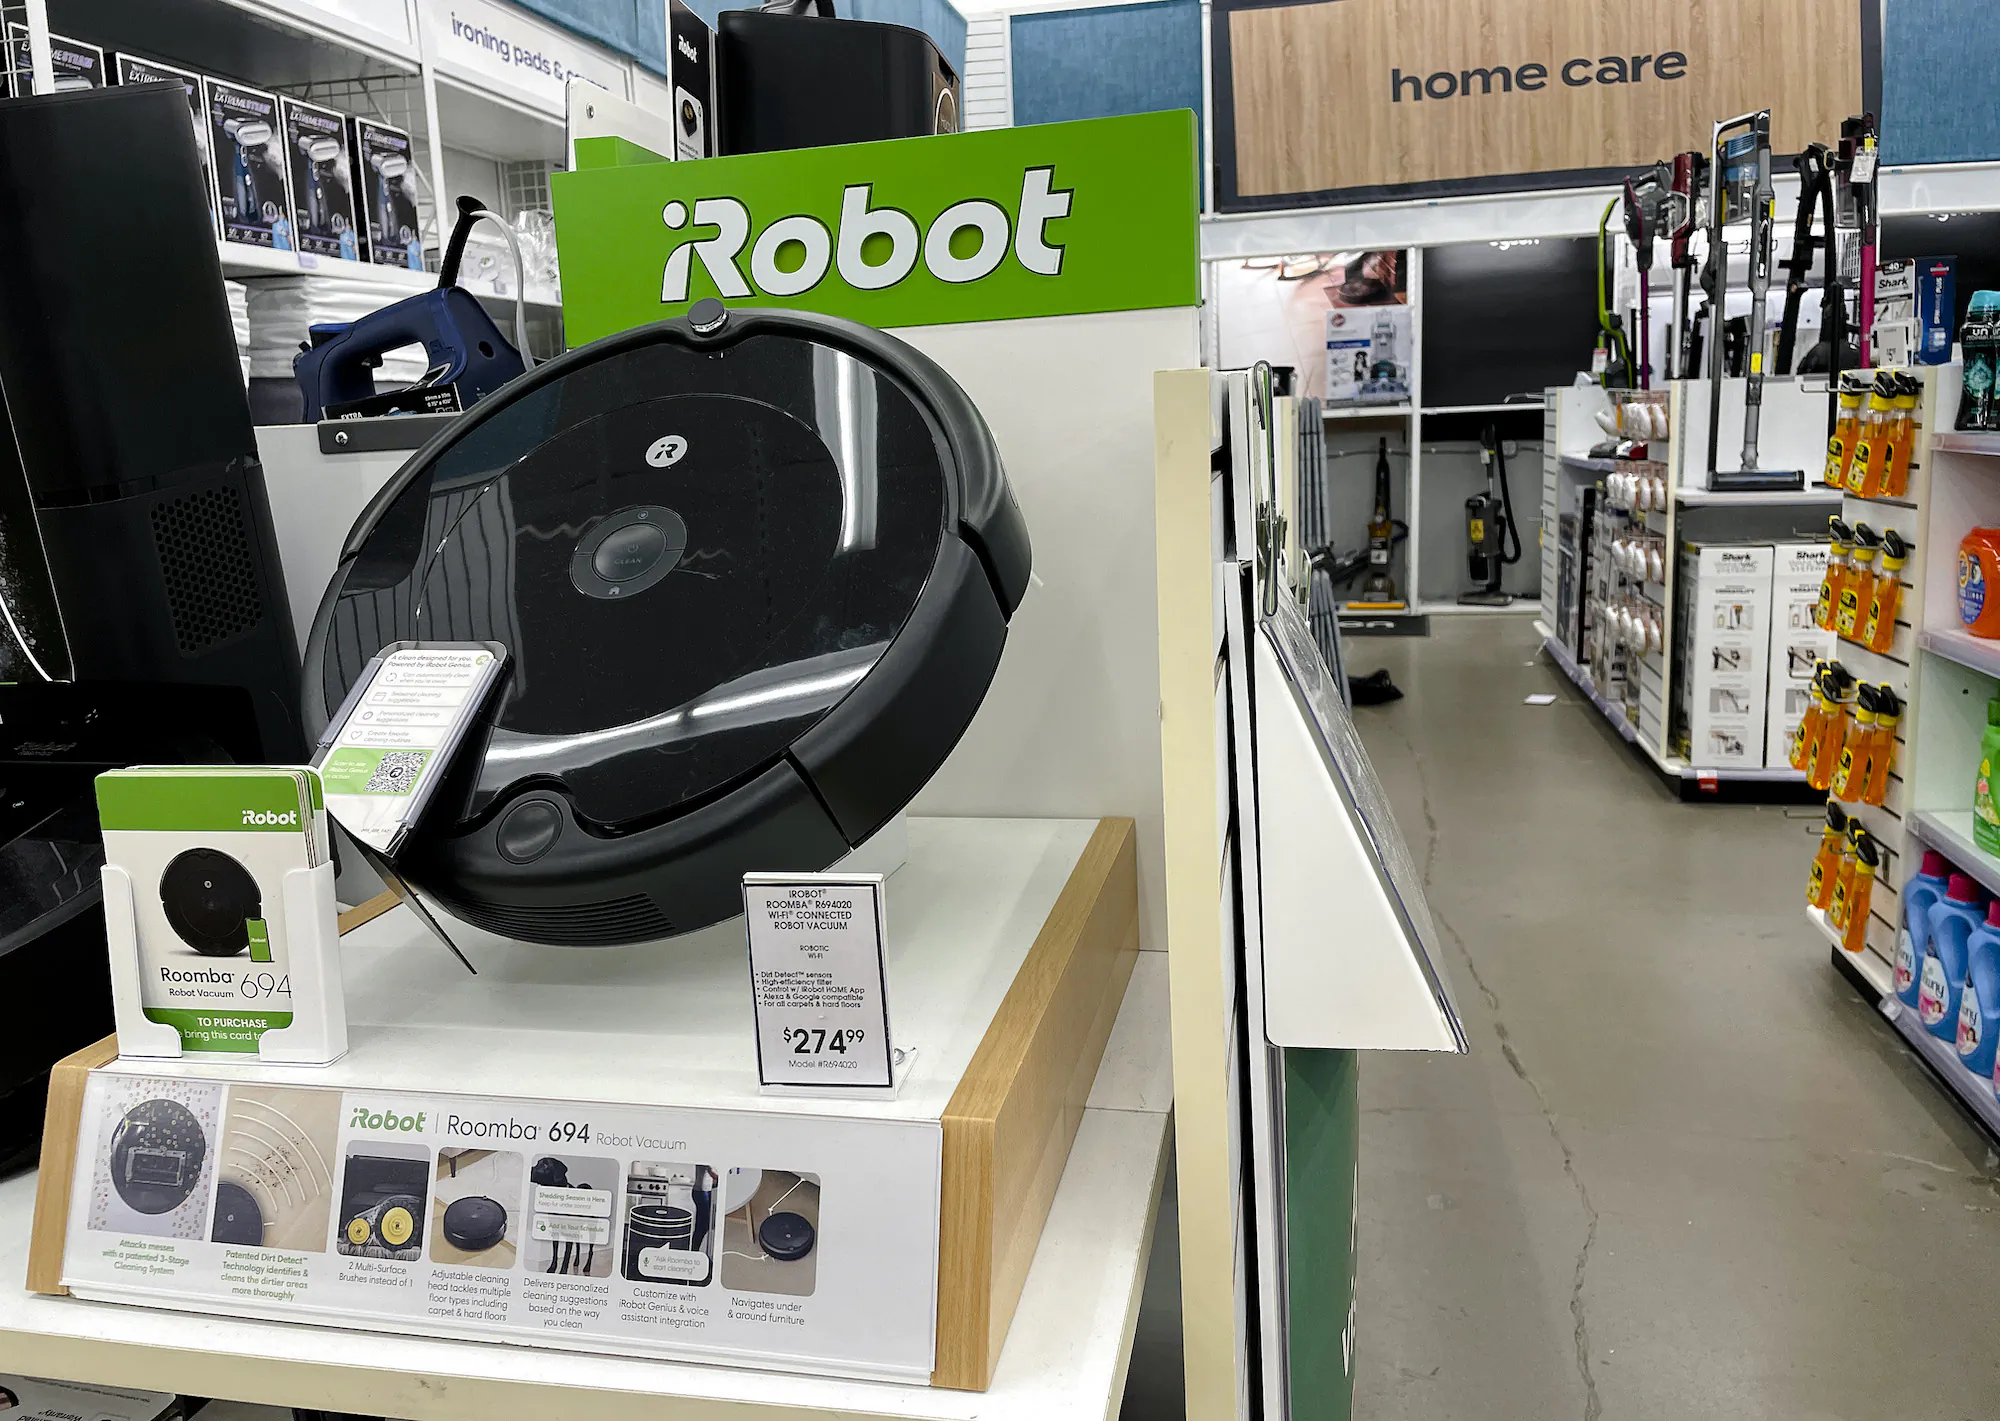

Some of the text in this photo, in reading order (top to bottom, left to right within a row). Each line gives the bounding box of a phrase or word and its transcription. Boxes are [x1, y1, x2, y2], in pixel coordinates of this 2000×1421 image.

[452, 13, 510, 62] ironing
[514, 46, 550, 75] pads
[554, 61, 563, 80] &
[1392, 51, 1687, 102] home care
[661, 164, 1074, 303] iRobot
[1879, 276, 1908, 289] Shark
[341, 412, 363, 420] EXTRA
[1722, 553, 1752, 561] Shark
[1797, 552, 1825, 560] Shark
[242, 810, 296, 825] iRobot
[815, 901, 852, 909] R694020
[169, 988, 234, 998] Robot Vacuum
[240, 973, 292, 999] 694
[197, 1017, 267, 1028] TO PURCHASE
[185, 1029, 209, 1041] bring
[211, 1030, 227, 1040] this
[229, 1030, 253, 1040] card
[789, 1060, 815, 1068] Model
[350, 1107, 426, 1133] iRobot
[549, 1121, 590, 1143] 694
[596, 1132, 633, 1147] Robot
[636, 1136, 687, 1150] Vacuum
[119, 1240, 174, 1252] Attacks messes
[103, 1249, 117, 1258] with
[125, 1251, 158, 1262] patented
[160, 1255, 189, 1266] 3-Stage
[226, 1250, 259, 1261] Patented
[261, 1252, 276, 1262] Dirt
[668, 1256, 693, 1265] Roomba
[114, 1262, 175, 1276] Cleaning System
[223, 1262, 308, 1277] Technology identifies &
[355, 1263, 407, 1274] Multi-Surface
[221, 1273, 308, 1289] cleans the dirtier areas
[339, 1273, 413, 1287] Brushes instead of 1
[432, 1270, 510, 1287] Adjustable cleaning
[524, 1278, 609, 1293] Delivers personalized
[232, 1287, 295, 1301] more thoroughly
[428, 1281, 511, 1298] head tackles multiple
[633, 1288, 696, 1301] Customize with
[429, 1294, 507, 1311] floor types including
[523, 1291, 608, 1307] cleaning suggestions
[731, 1297, 802, 1312] Navigates under
[428, 1307, 507, 1321] carpet & hard floors
[529, 1304, 555, 1314] based
[569, 1308, 582, 1316] the
[584, 1311, 600, 1320] way
[619, 1300, 709, 1316] iRobot Genius & voice
[544, 1319, 582, 1329] you clean
[621, 1313, 705, 1328] assistant integration
[728, 1309, 804, 1325] & around furniture
